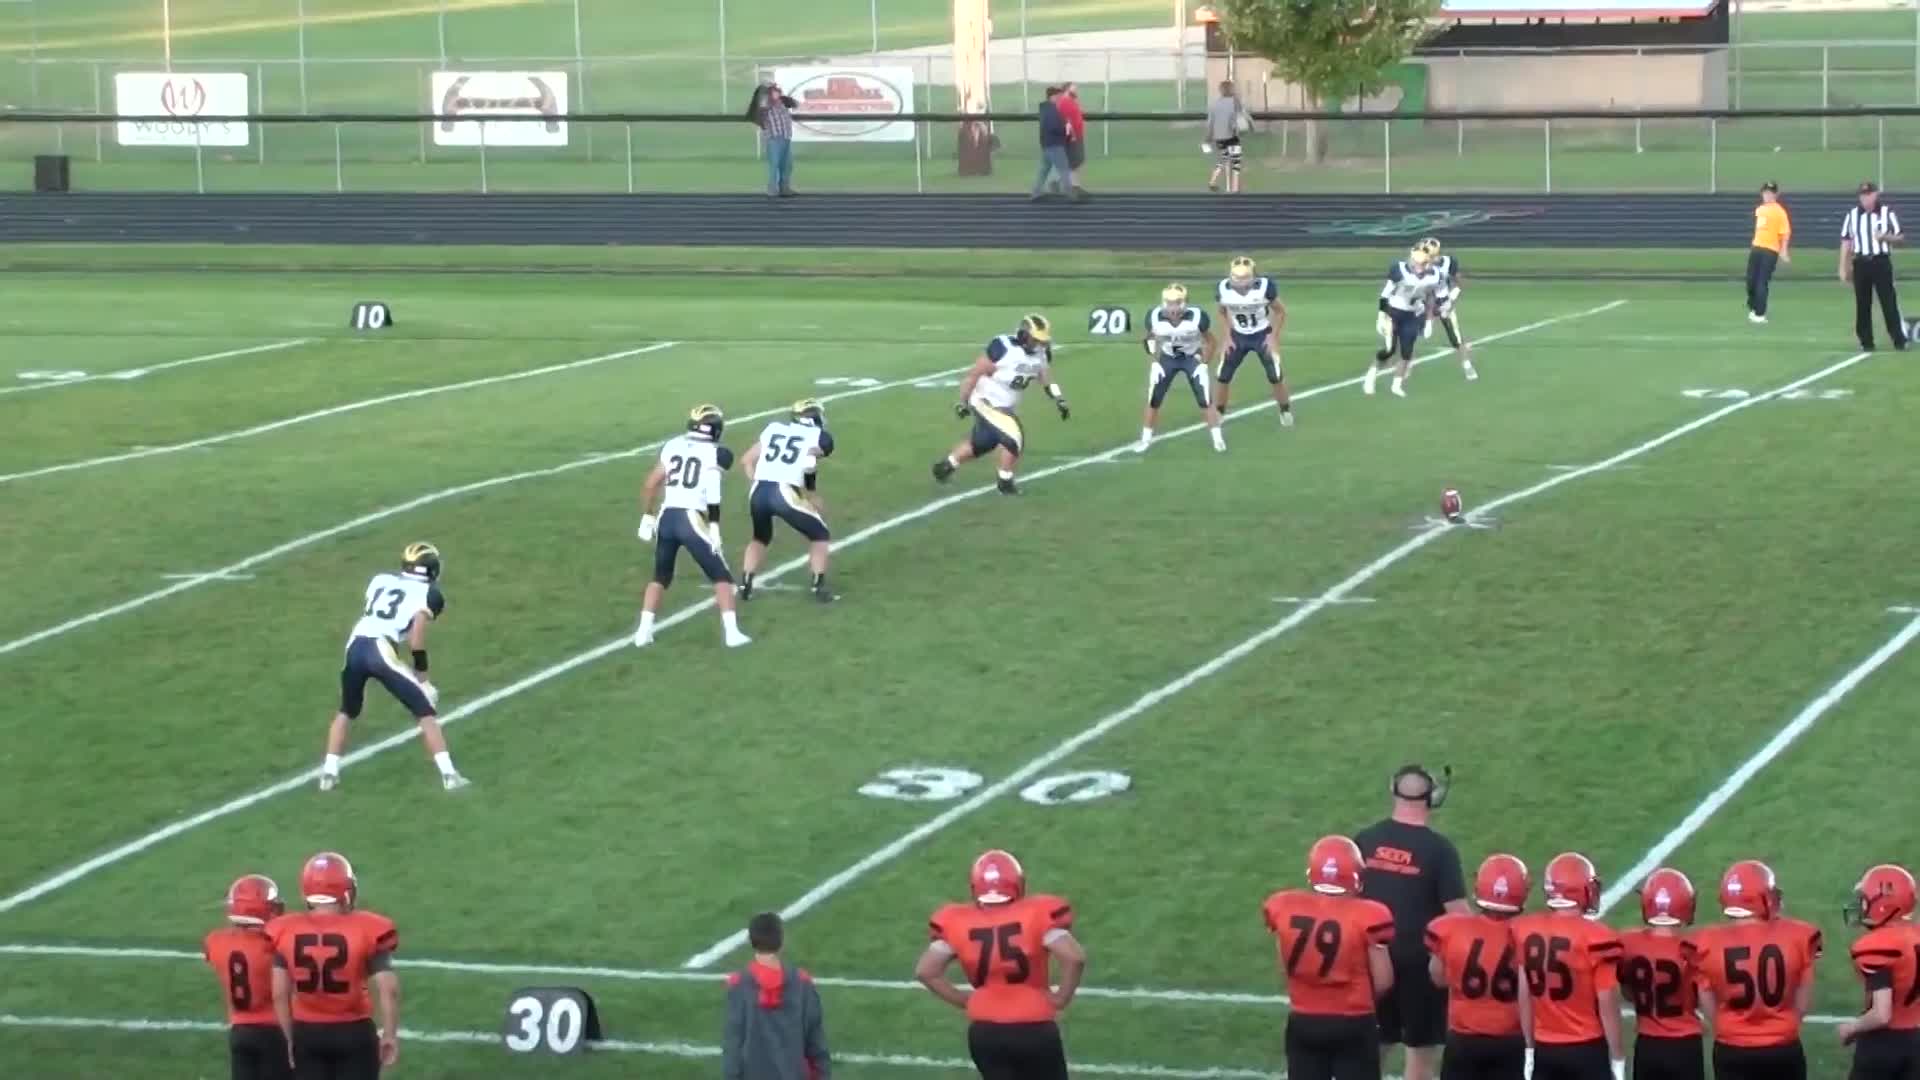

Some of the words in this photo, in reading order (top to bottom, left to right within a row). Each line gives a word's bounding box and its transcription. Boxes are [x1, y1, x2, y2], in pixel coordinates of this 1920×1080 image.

[357, 305, 385, 329] 10
[1090, 309, 1127, 334] 20
[664, 455, 701, 489] 20
[765, 434, 801, 464] 55
[365, 587, 407, 620] 13
[294, 933, 350, 994] 52
[969, 922, 1030, 989] 75
[1288, 915, 1341, 977] 79
[1462, 938, 1519, 1003] 66
[1524, 933, 1573, 1001] 85
[1724, 943, 1785, 1008] 50
[229, 950, 253, 1010] 8
[1634, 955, 1683, 1017] 82
[506, 996, 582, 1054] 30
